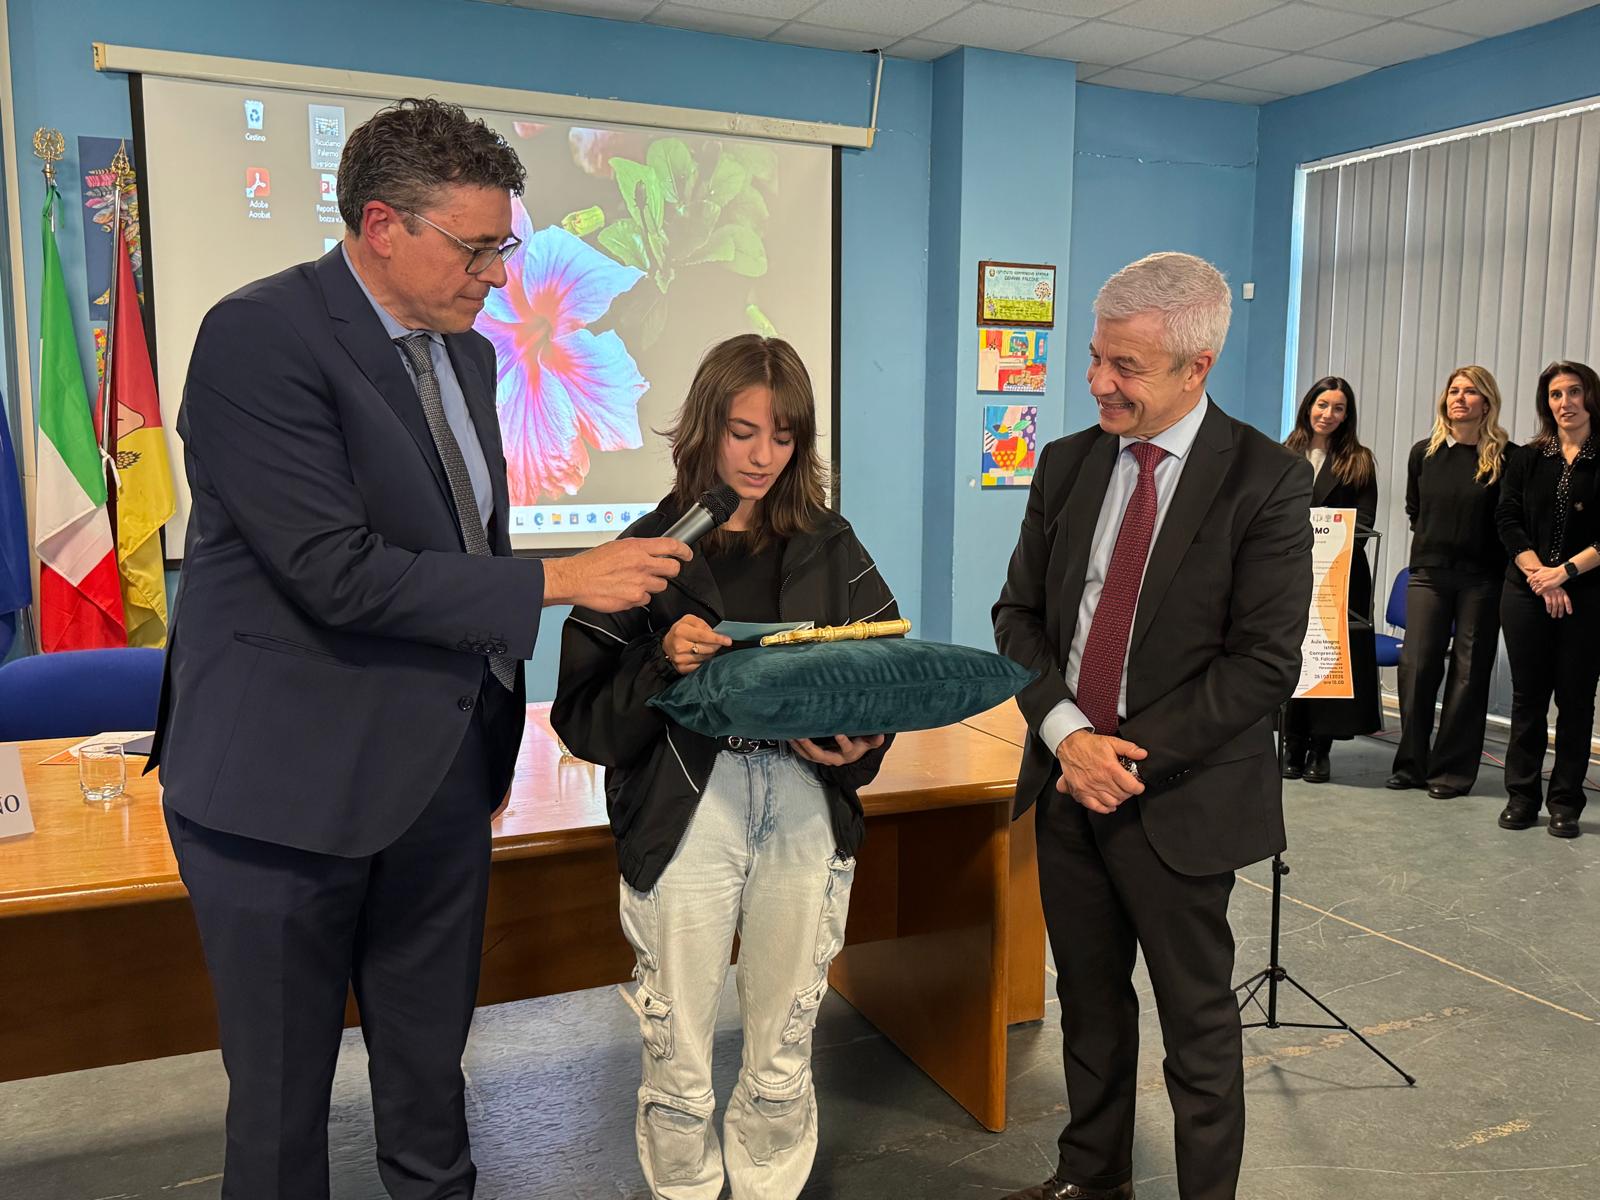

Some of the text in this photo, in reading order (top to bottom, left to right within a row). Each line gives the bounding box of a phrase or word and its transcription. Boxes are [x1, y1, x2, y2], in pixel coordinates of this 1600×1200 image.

[245, 132, 267, 142] Cestino
[249, 200, 269, 209] Adobe
[248, 210, 271, 219] Acrobat
